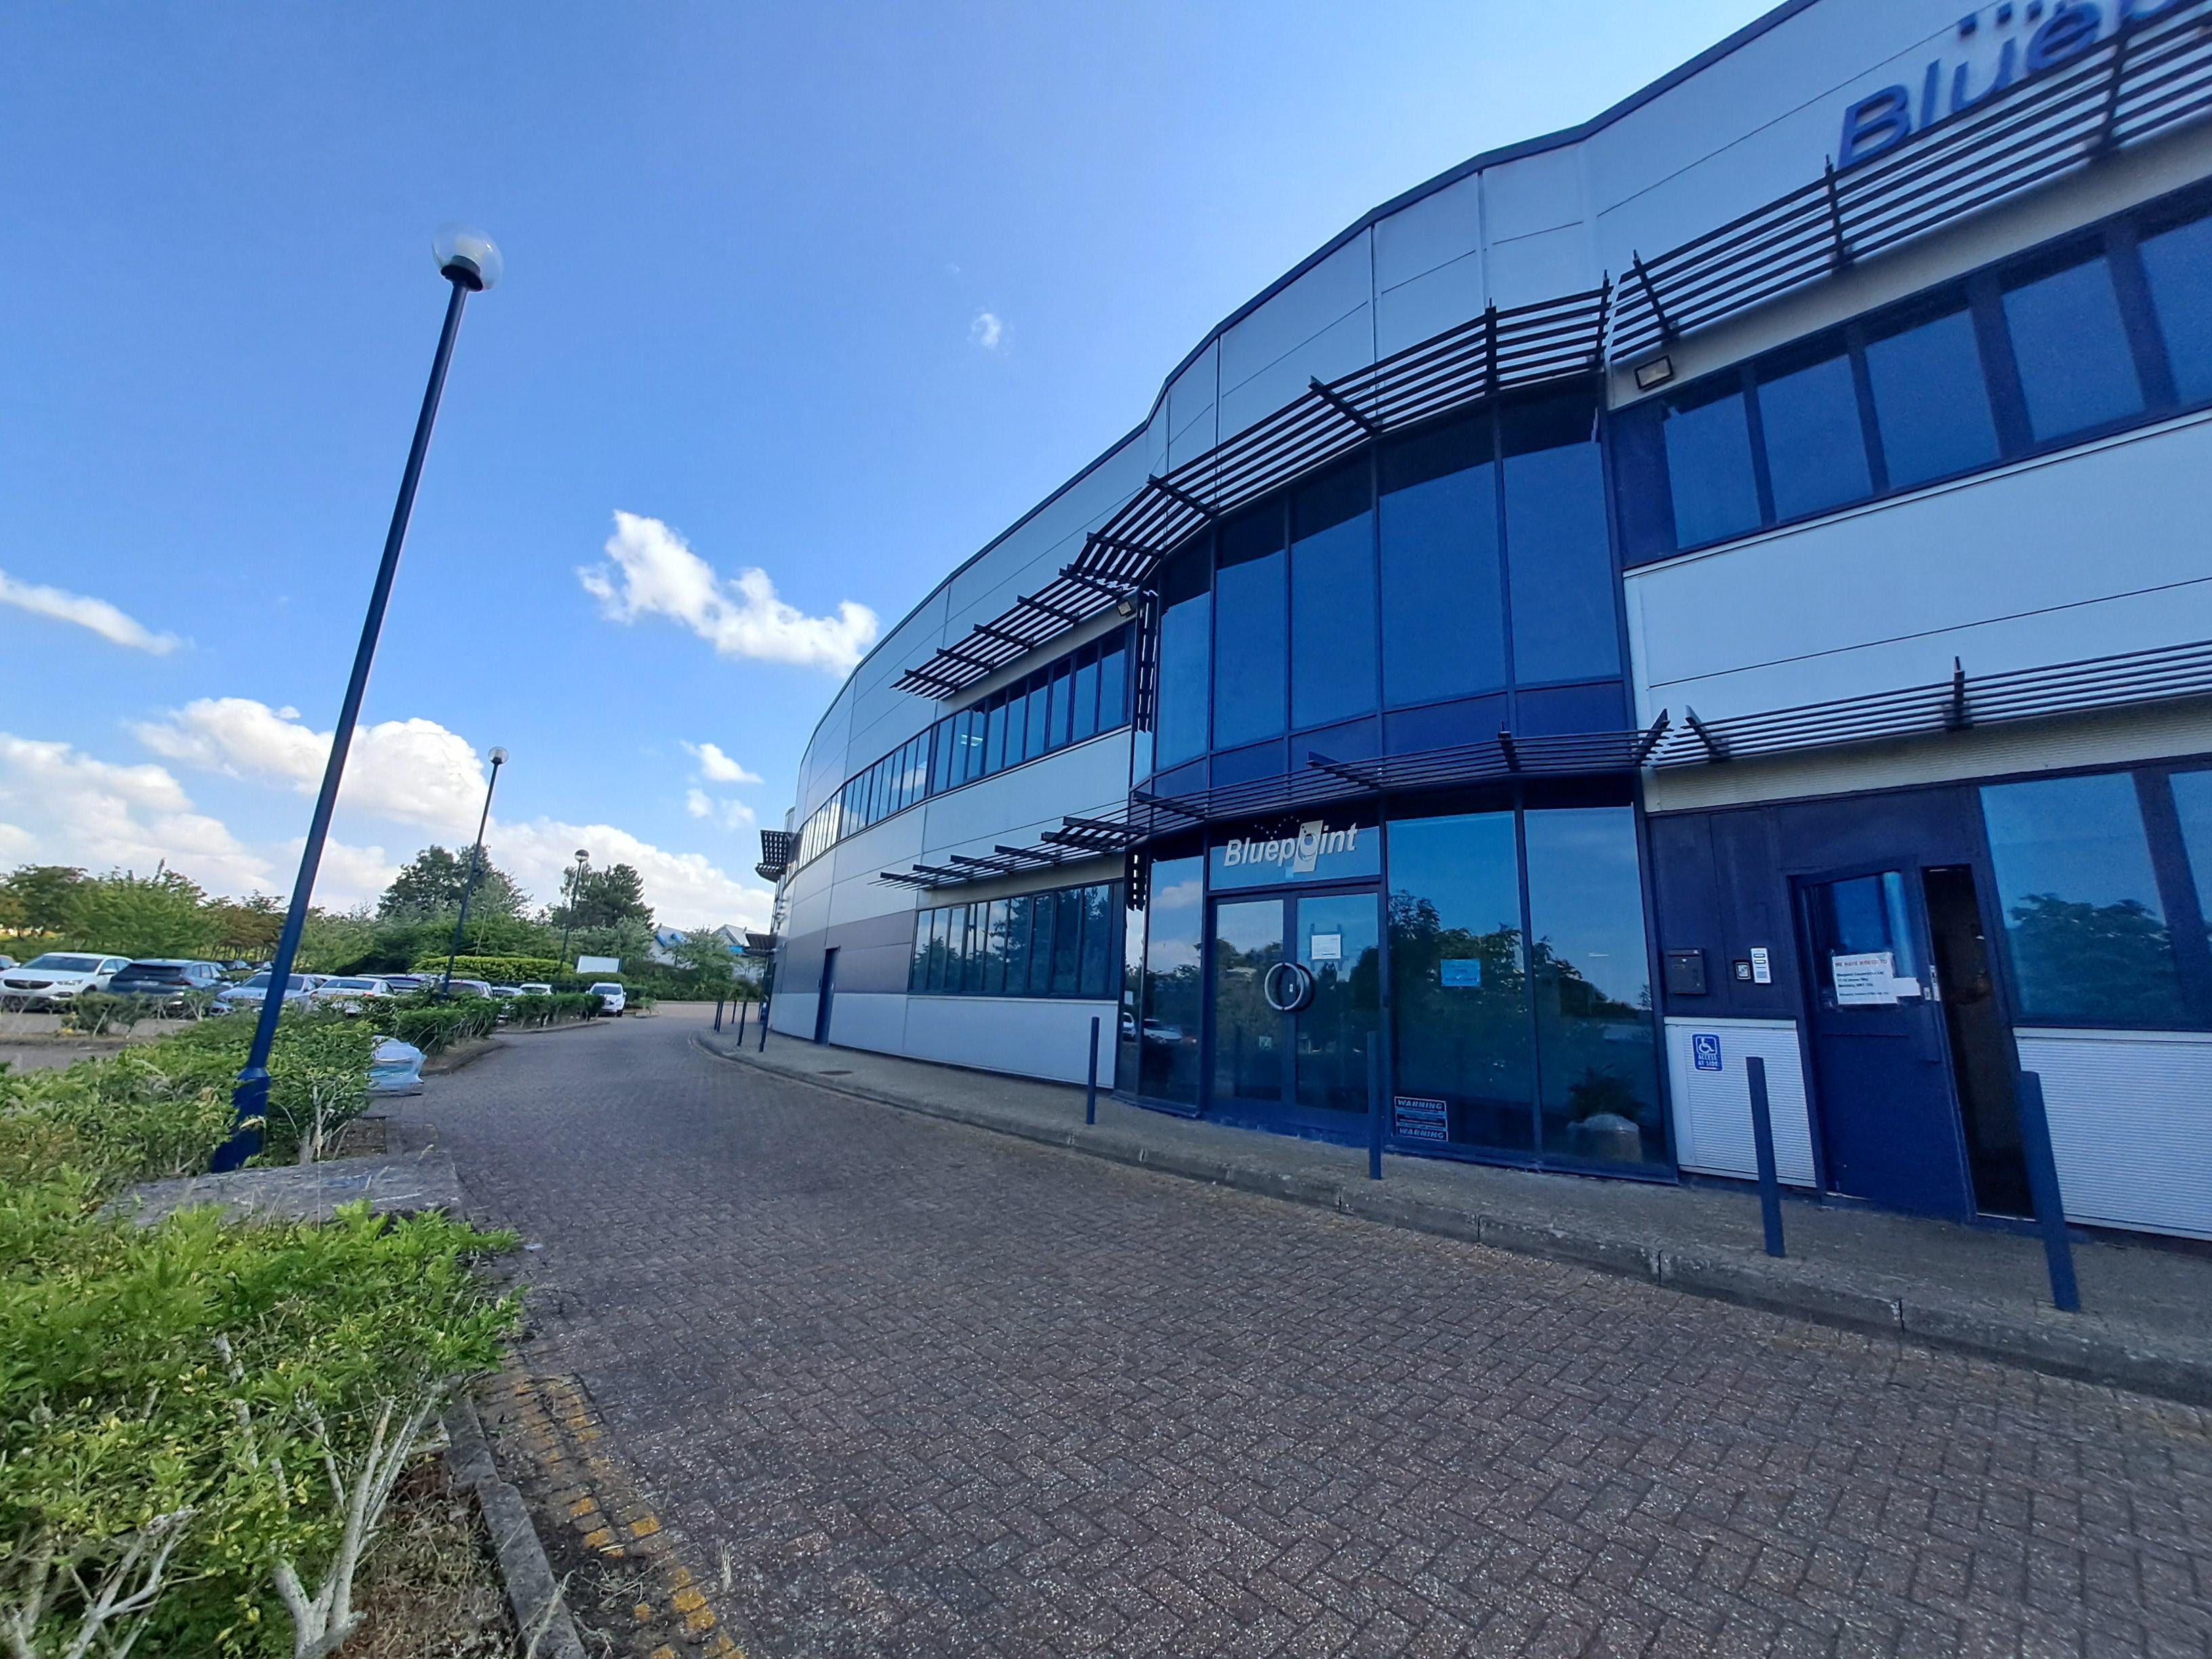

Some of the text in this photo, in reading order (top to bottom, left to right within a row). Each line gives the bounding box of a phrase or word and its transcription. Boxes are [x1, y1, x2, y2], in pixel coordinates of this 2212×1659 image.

[1224, 821, 1357, 871] Bluepoint
[1397, 1099, 1443, 1109] WARNING
[1399, 1127, 1444, 1139] WARNING
